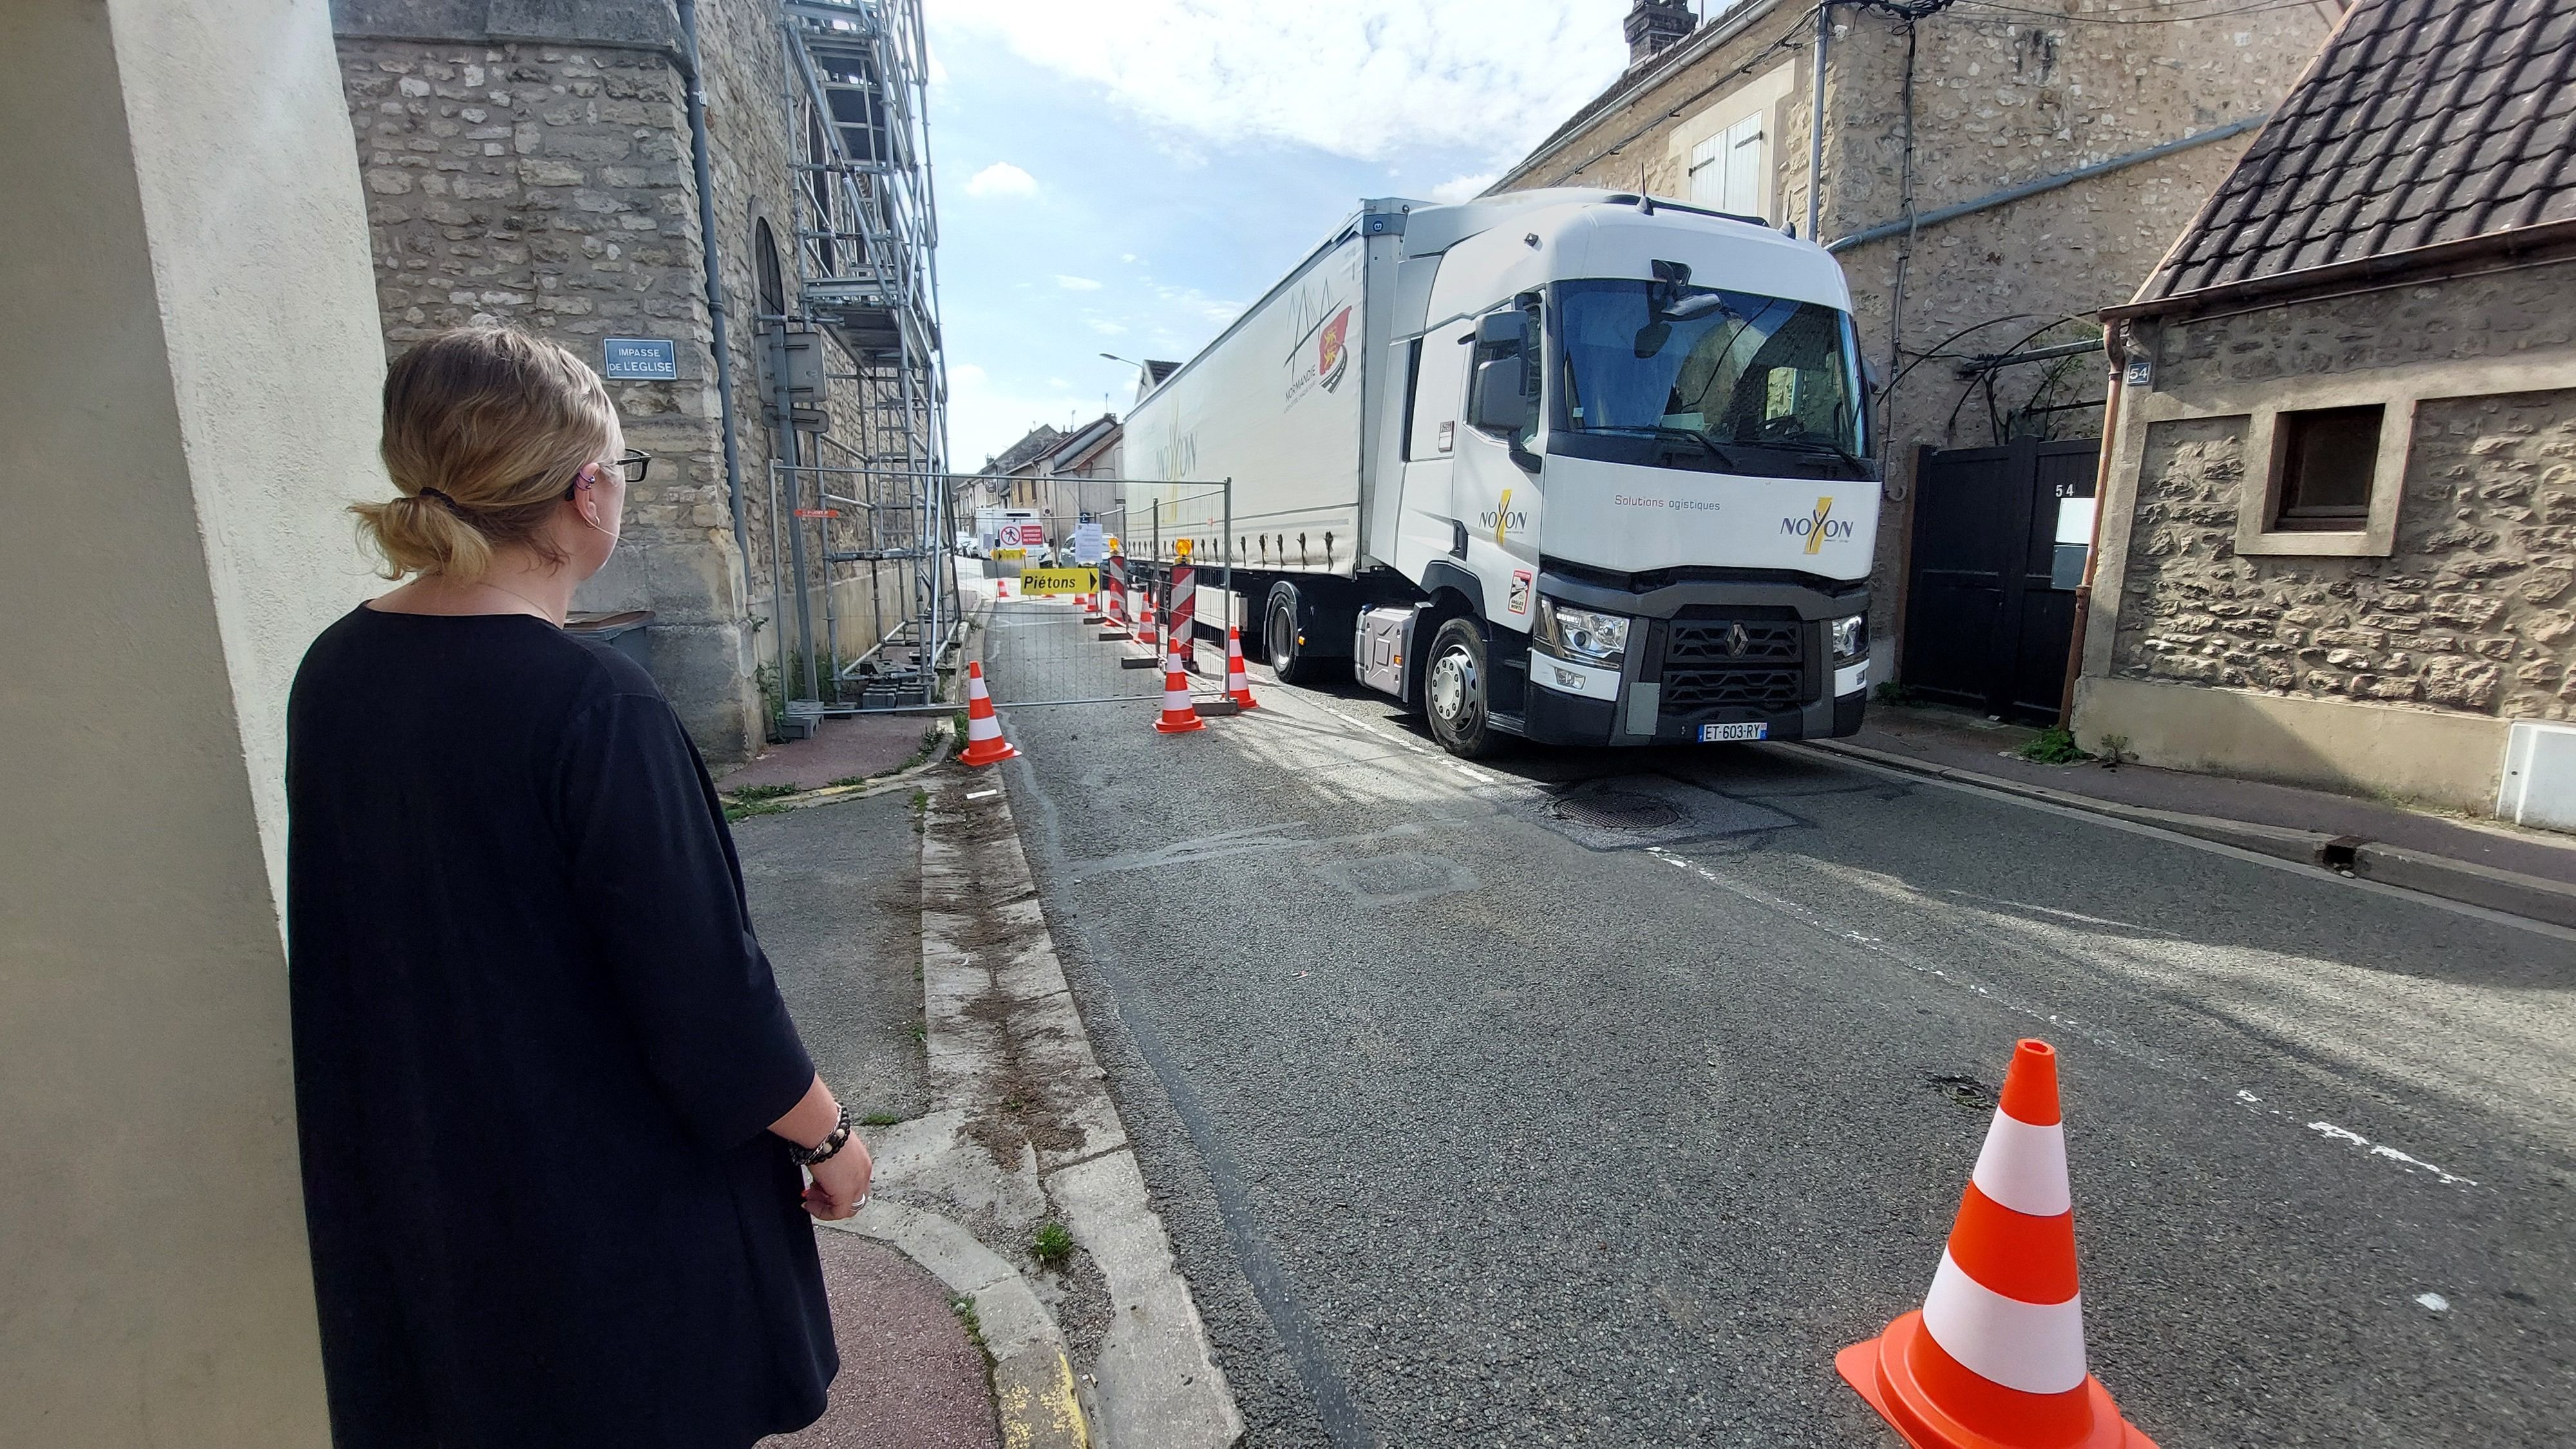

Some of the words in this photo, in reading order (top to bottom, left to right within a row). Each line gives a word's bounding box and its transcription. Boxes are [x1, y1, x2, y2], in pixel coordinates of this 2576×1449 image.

[619, 348, 661, 357] IMPASSE
[609, 363, 622, 372] DE
[623, 362, 673, 372] L'EGLISE
[2129, 367, 2148, 380] 54
[1285, 364, 1316, 402] NORMANDIE
[2056, 484, 2074, 497] 54
[1615, 495, 1664, 507] Solutions
[1479, 493, 1528, 545] NOYON
[1780, 502, 1853, 551] NOYON
[1024, 576, 1076, 589] Piétons
[1705, 724, 1761, 740] ET-603-RY
